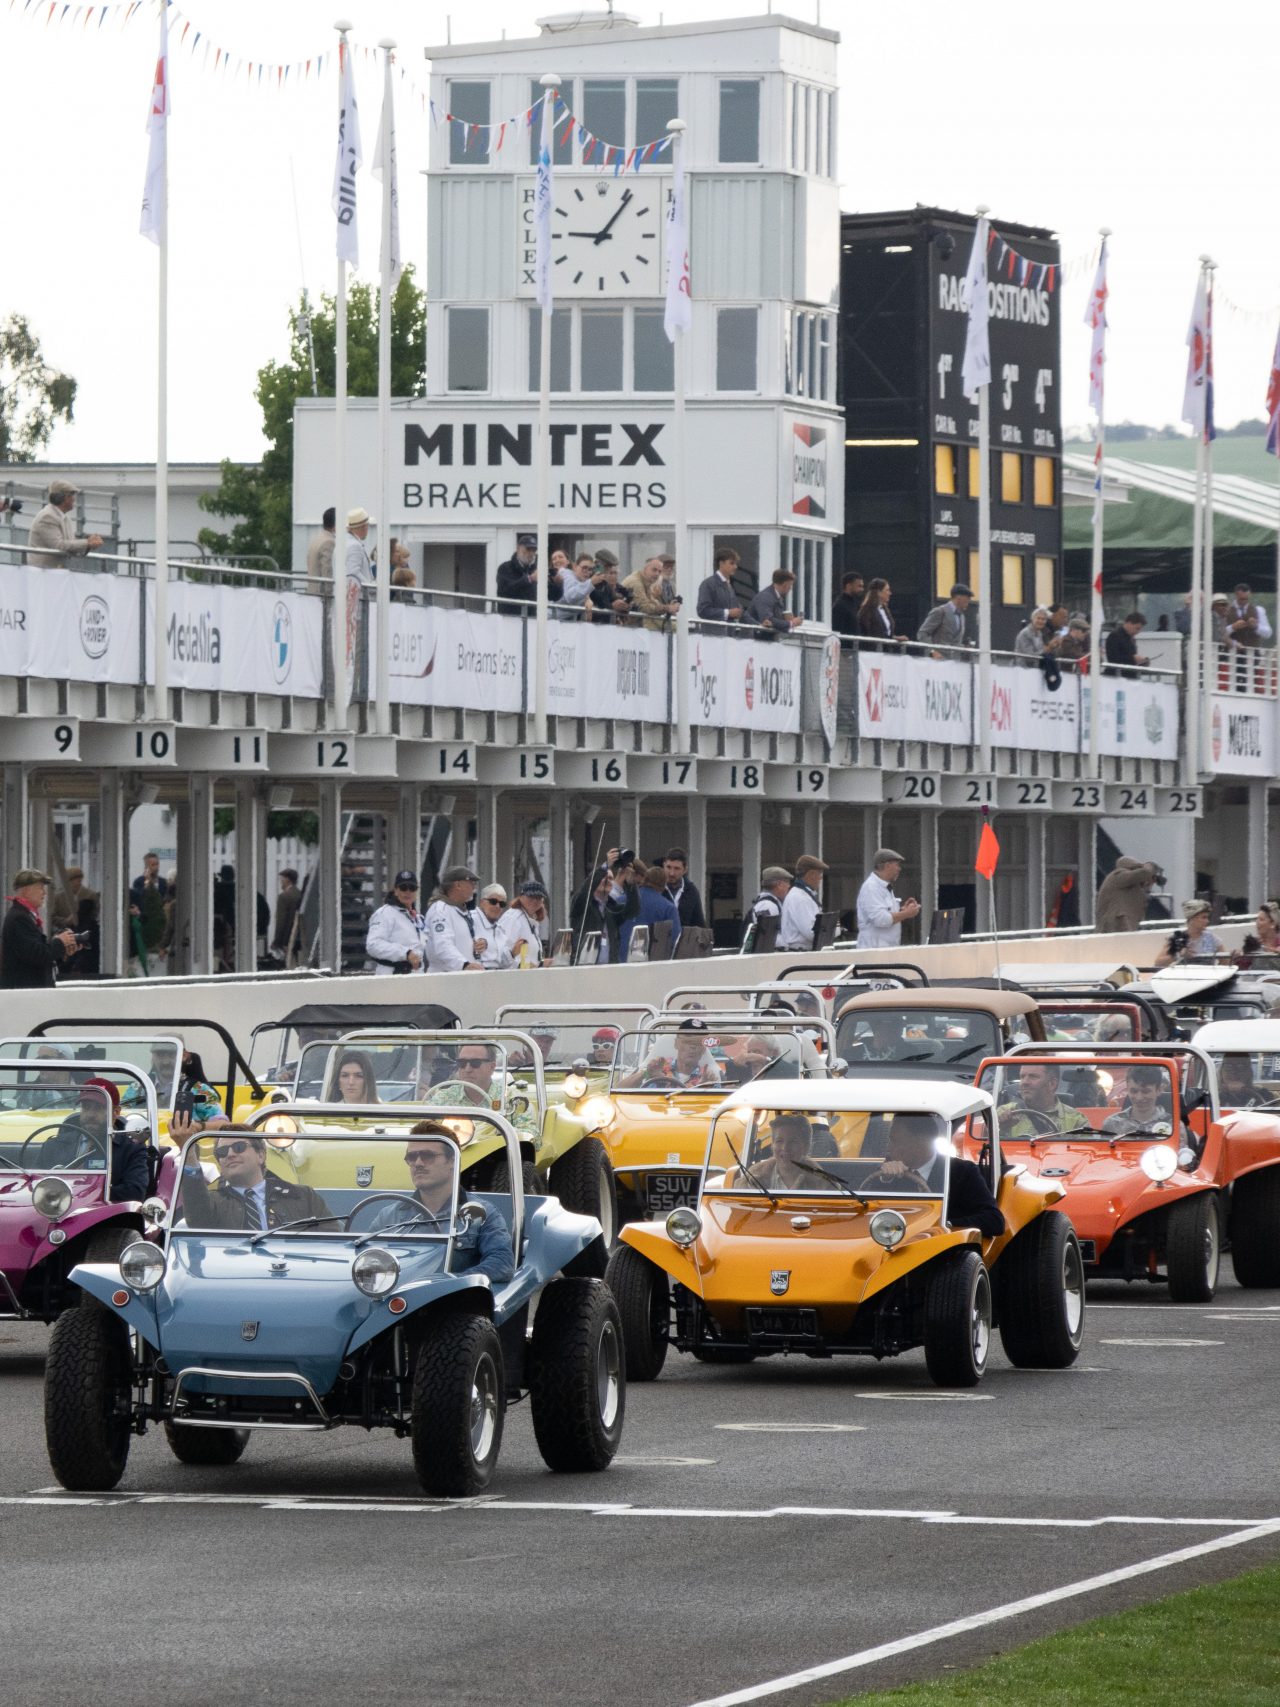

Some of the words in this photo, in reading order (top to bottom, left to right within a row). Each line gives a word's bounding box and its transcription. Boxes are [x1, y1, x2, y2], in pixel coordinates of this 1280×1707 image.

[939, 274, 972, 313] RAC
[988, 282, 1050, 326] OSITIONS
[404, 424, 666, 466] MINTEX
[404, 483, 521, 508] BRAKE
[54, 724, 73, 753] 9
[135, 730, 169, 758] 10
[233, 736, 261, 763] 11
[317, 741, 349, 768] 12
[439, 748, 470, 774] 14
[519, 753, 549, 779] 15
[591, 758, 622, 782] 16
[662, 760, 692, 785] 17
[730, 765, 759, 789] 18
[796, 769, 824, 793] 19
[905, 777, 935, 798] 20
[966, 780, 992, 802] 21
[1016, 782, 1047, 804] 22
[1071, 786, 1100, 808] 23
[1119, 788, 1148, 810] 24
[1169, 791, 1197, 812] 25
[655, 1177, 691, 1193] SUV
